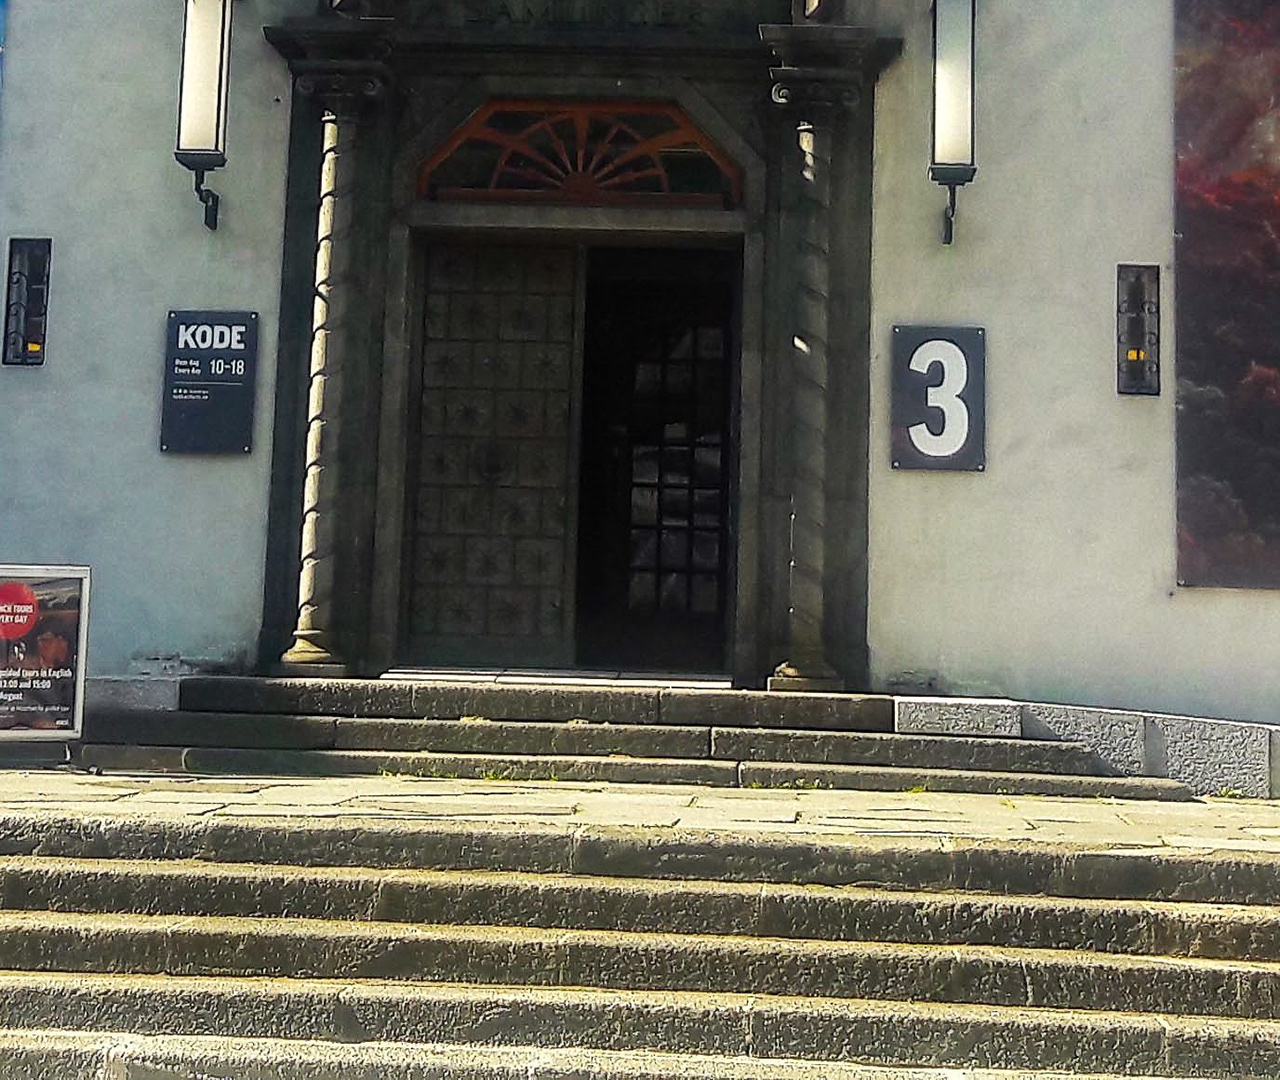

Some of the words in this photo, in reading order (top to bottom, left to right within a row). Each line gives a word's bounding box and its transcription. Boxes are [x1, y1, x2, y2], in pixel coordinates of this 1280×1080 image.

[178, 324, 246, 350] KODE
[210, 359, 245, 375] 10-18
[908, 339, 969, 457] 3
[15, 615, 28, 624] DAY
[21, 668, 39, 678] tours
[48, 668, 72, 679] English
[19, 680, 32, 689] and
[0, 691, 23, 701] August
